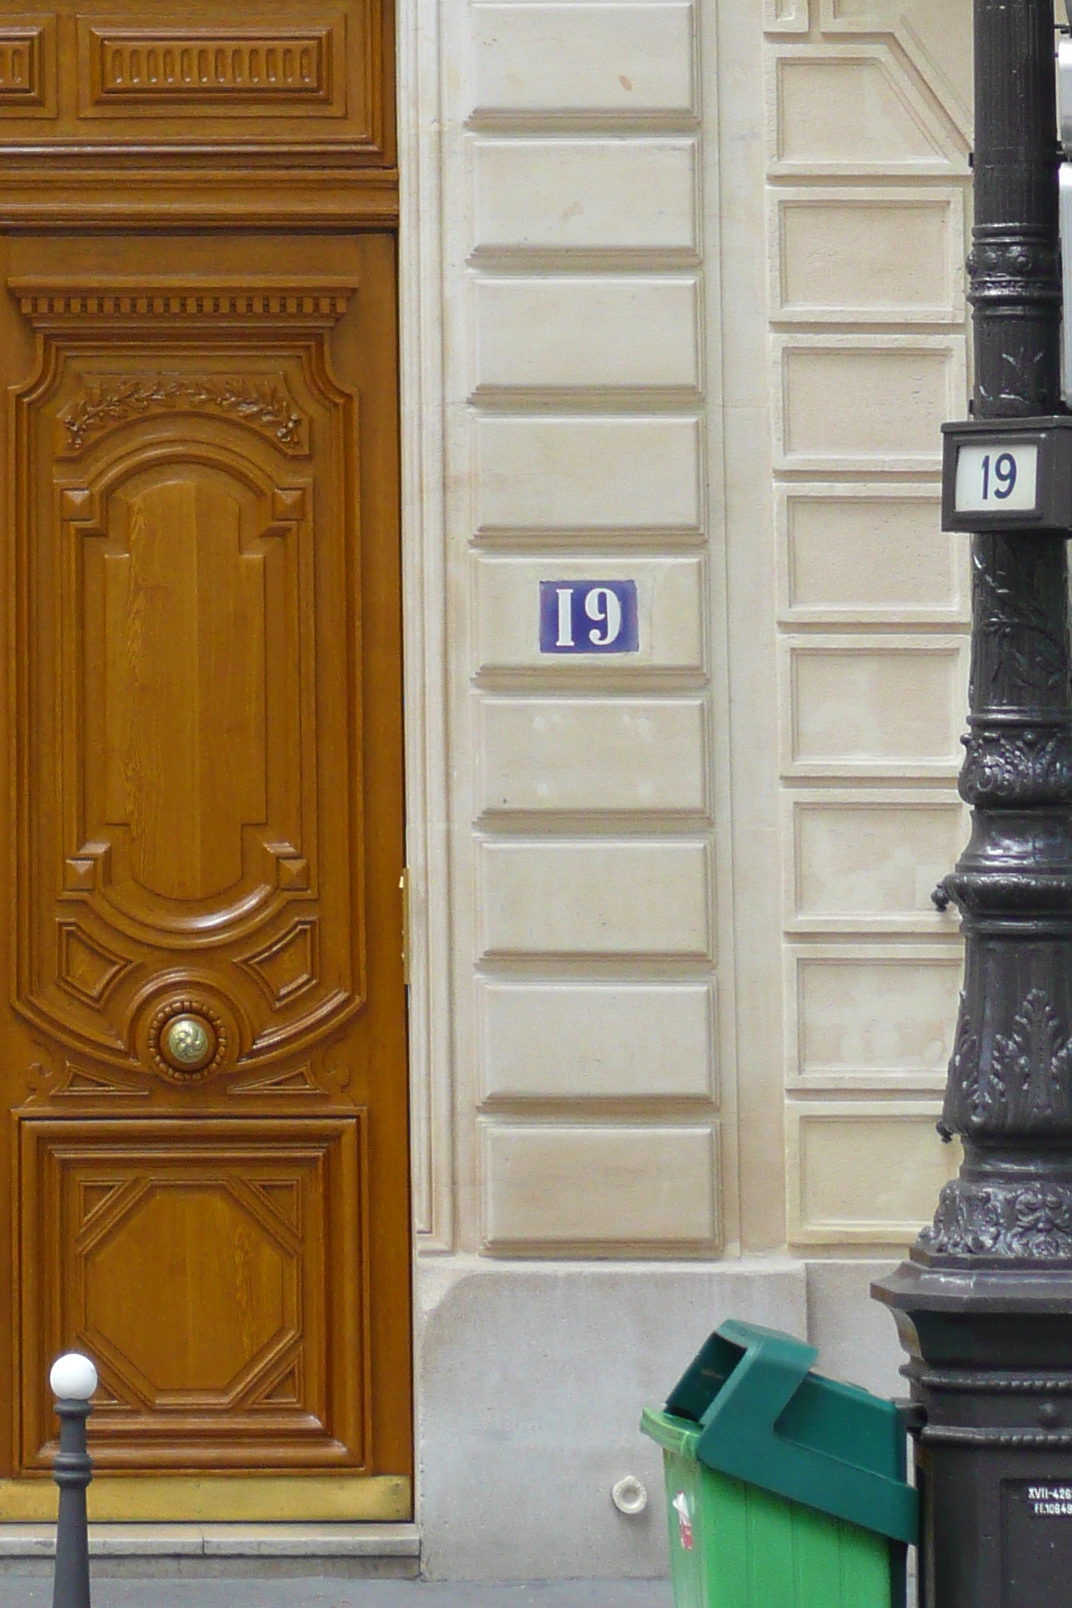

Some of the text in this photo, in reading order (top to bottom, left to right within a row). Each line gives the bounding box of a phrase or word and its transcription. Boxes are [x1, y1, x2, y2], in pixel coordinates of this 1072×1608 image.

[981, 453, 1017, 500] 19
[555, 587, 622, 646] 19
[1028, 1486, 1072, 1499] XVII-426
